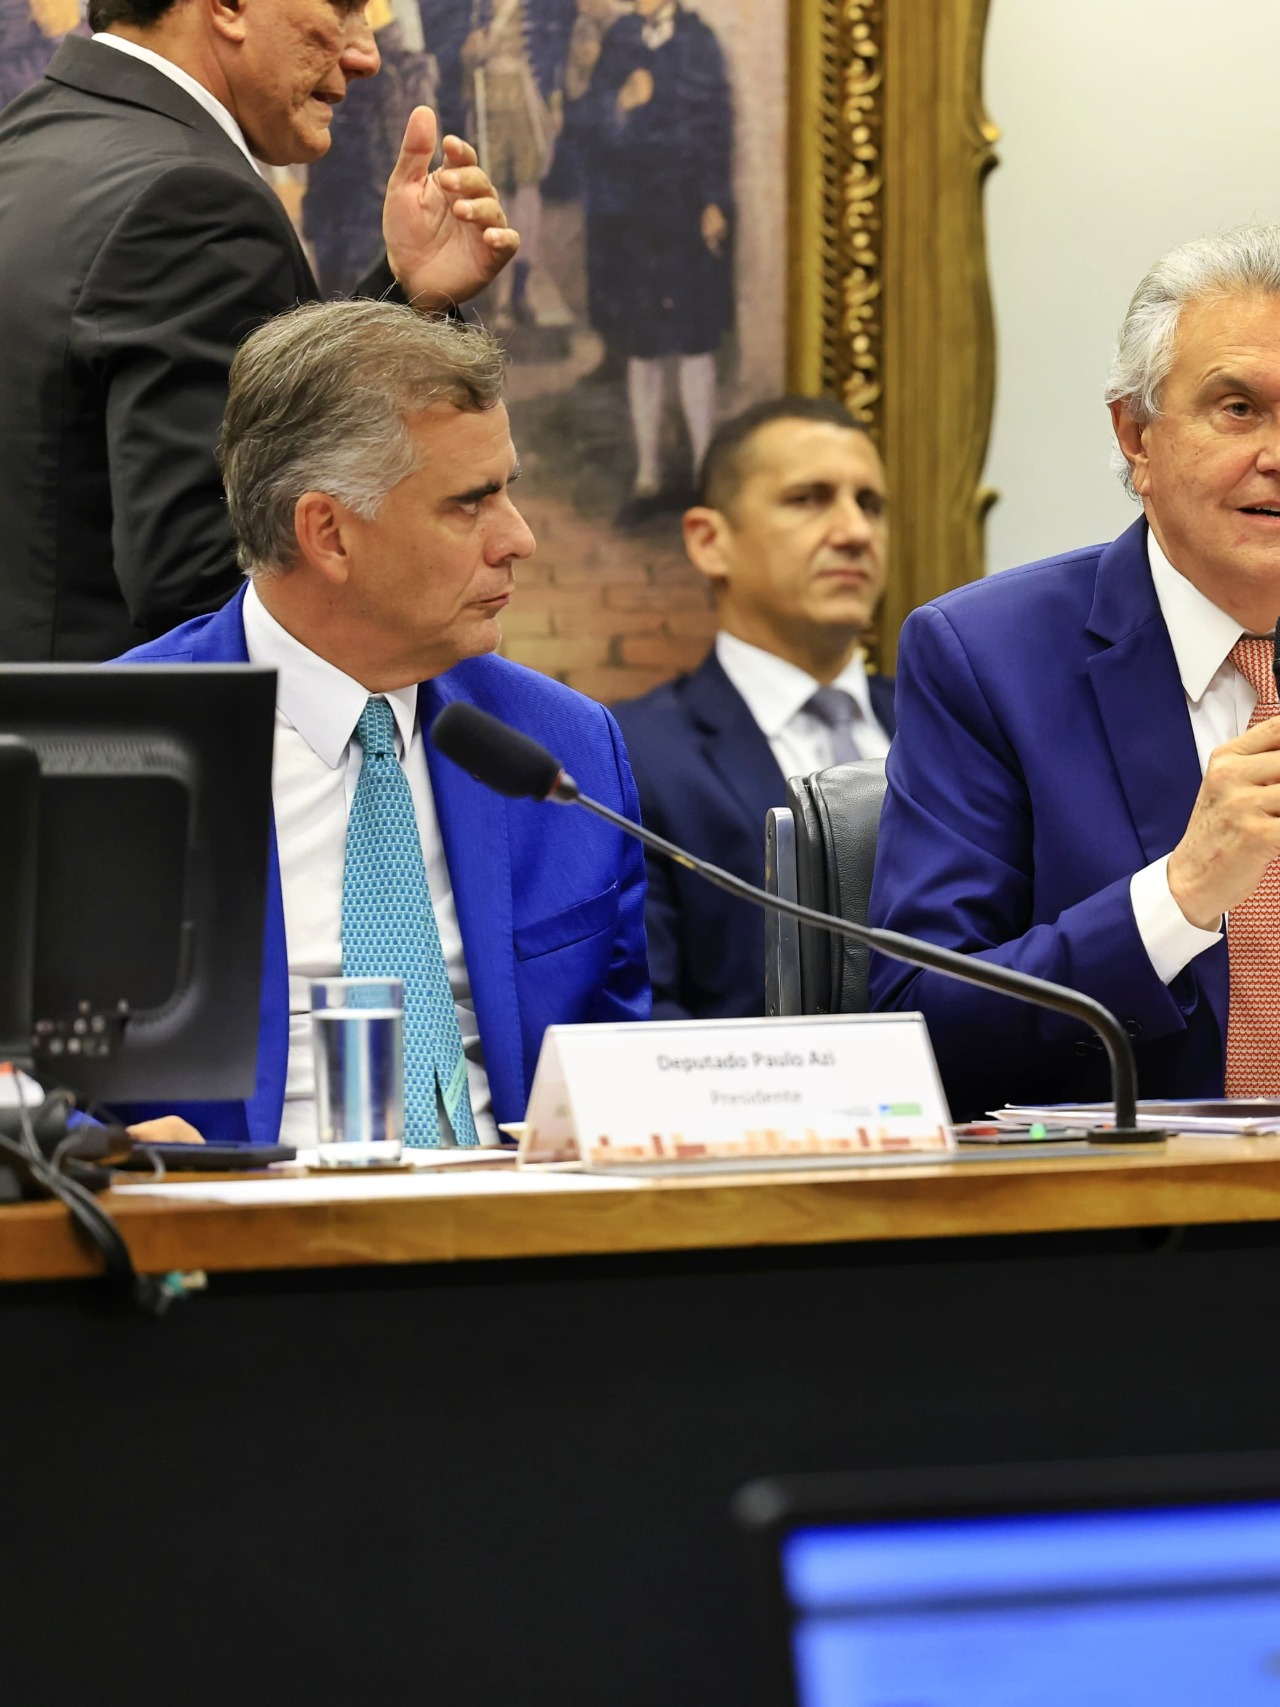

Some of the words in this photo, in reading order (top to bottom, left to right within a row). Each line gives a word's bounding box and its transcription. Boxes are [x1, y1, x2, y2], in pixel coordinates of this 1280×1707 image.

[656, 1053, 748, 1073] Deputado
[752, 1051, 805, 1067] Paulo
[709, 1090, 803, 1105] Presidente
